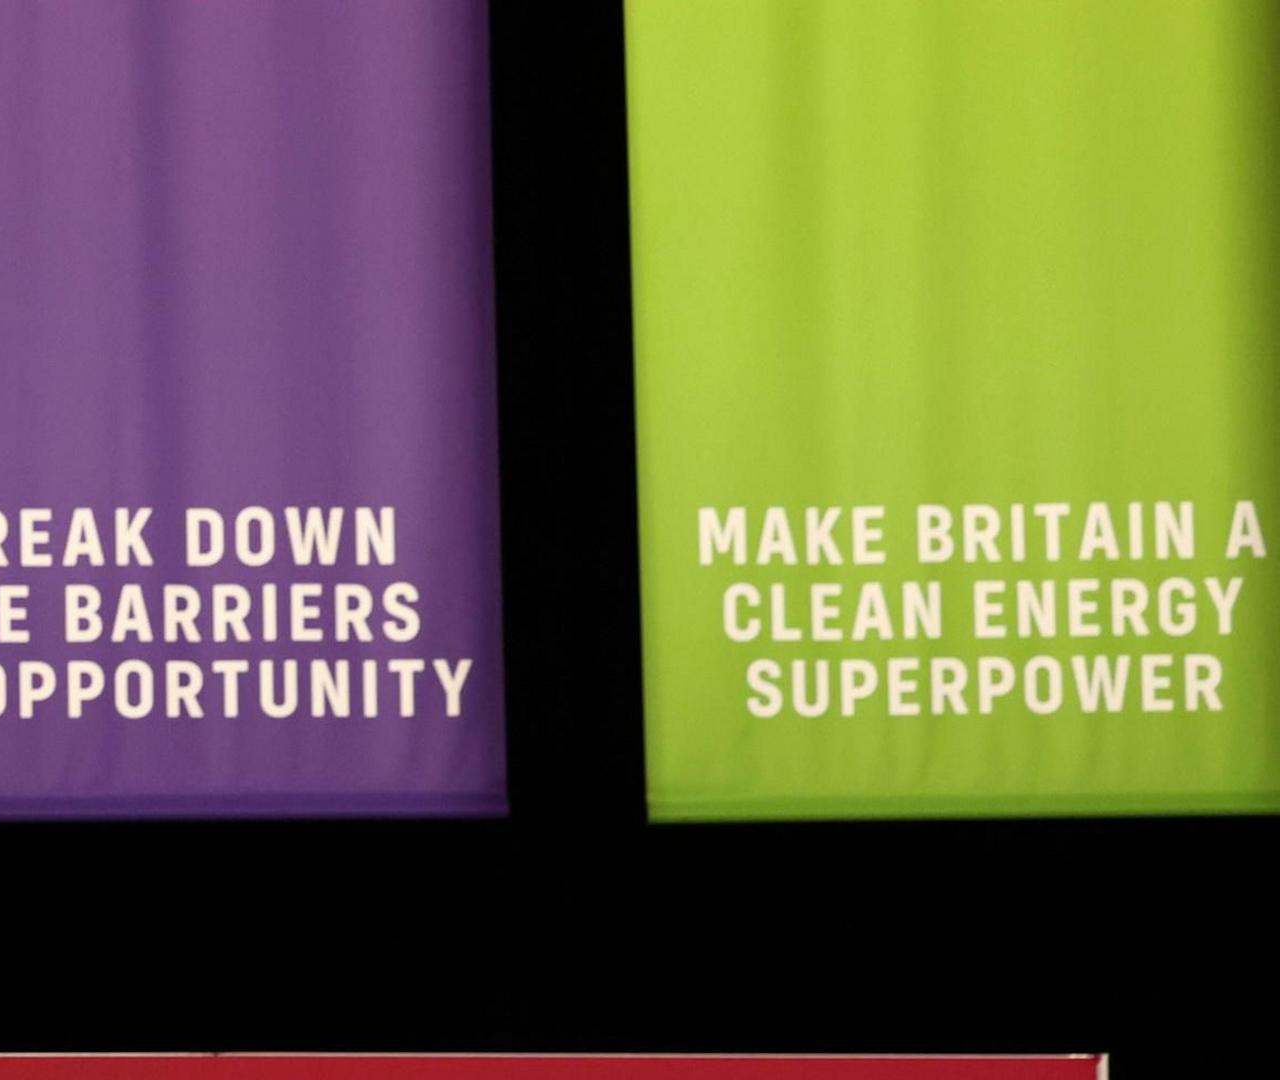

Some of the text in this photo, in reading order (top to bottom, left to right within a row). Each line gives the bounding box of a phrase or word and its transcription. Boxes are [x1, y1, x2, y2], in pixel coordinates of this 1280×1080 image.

[185, 506, 396, 567] DOWN
[698, 500, 1266, 566] MAKE BRITAIN A
[64, 581, 420, 643] BARRIERS
[723, 576, 1243, 642] CLEAN ENERGY
[746, 653, 1223, 718] SUPERPOWER
